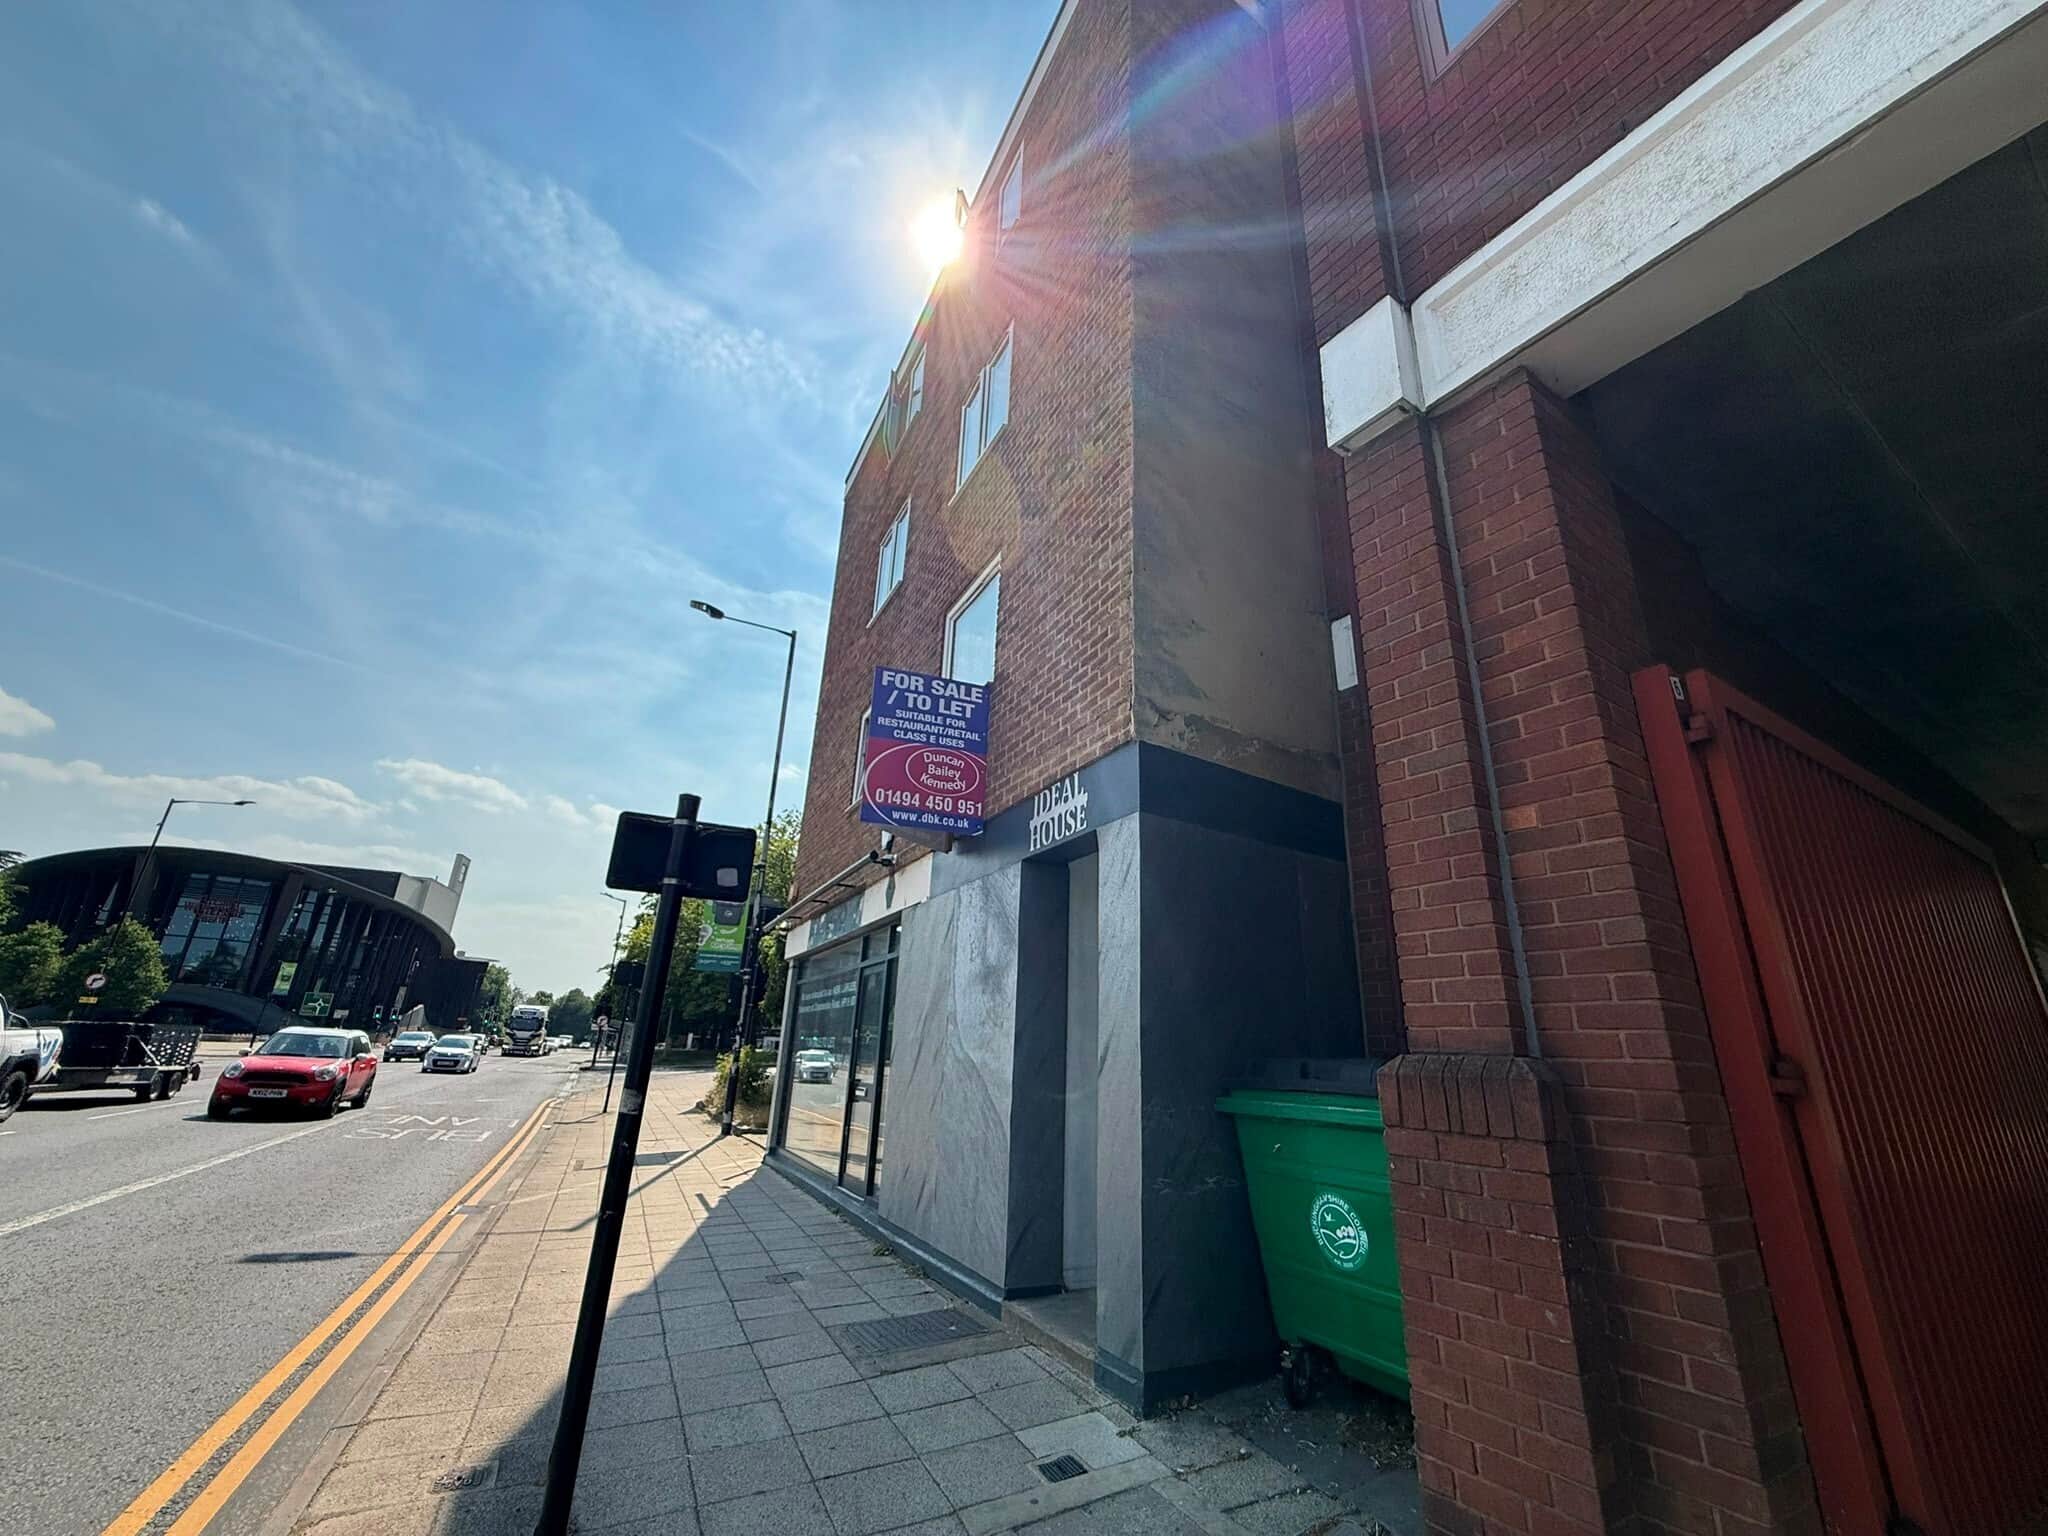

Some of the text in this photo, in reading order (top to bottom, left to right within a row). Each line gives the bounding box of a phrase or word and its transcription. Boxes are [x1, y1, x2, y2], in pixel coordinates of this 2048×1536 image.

[882, 670, 984, 704] FOR SALE
[905, 692, 932, 711] TO
[939, 698, 976, 719] LET
[877, 716, 982, 742] RESTAURANT/RETAIL
[895, 709, 967, 729] SUITABLE FOR
[893, 729, 965, 749] CLASS E USES
[923, 751, 965, 769] Duncan
[920, 772, 966, 792] Kennedy
[928, 764, 961, 781] Bailey
[875, 788, 983, 817] 01494 450 951
[1032, 771, 1085, 820] IDEAL
[891, 810, 969, 829] www.dbk.co.uk
[1029, 794, 1088, 852] HOUSE
[342, 1127, 493, 1142] BUS
